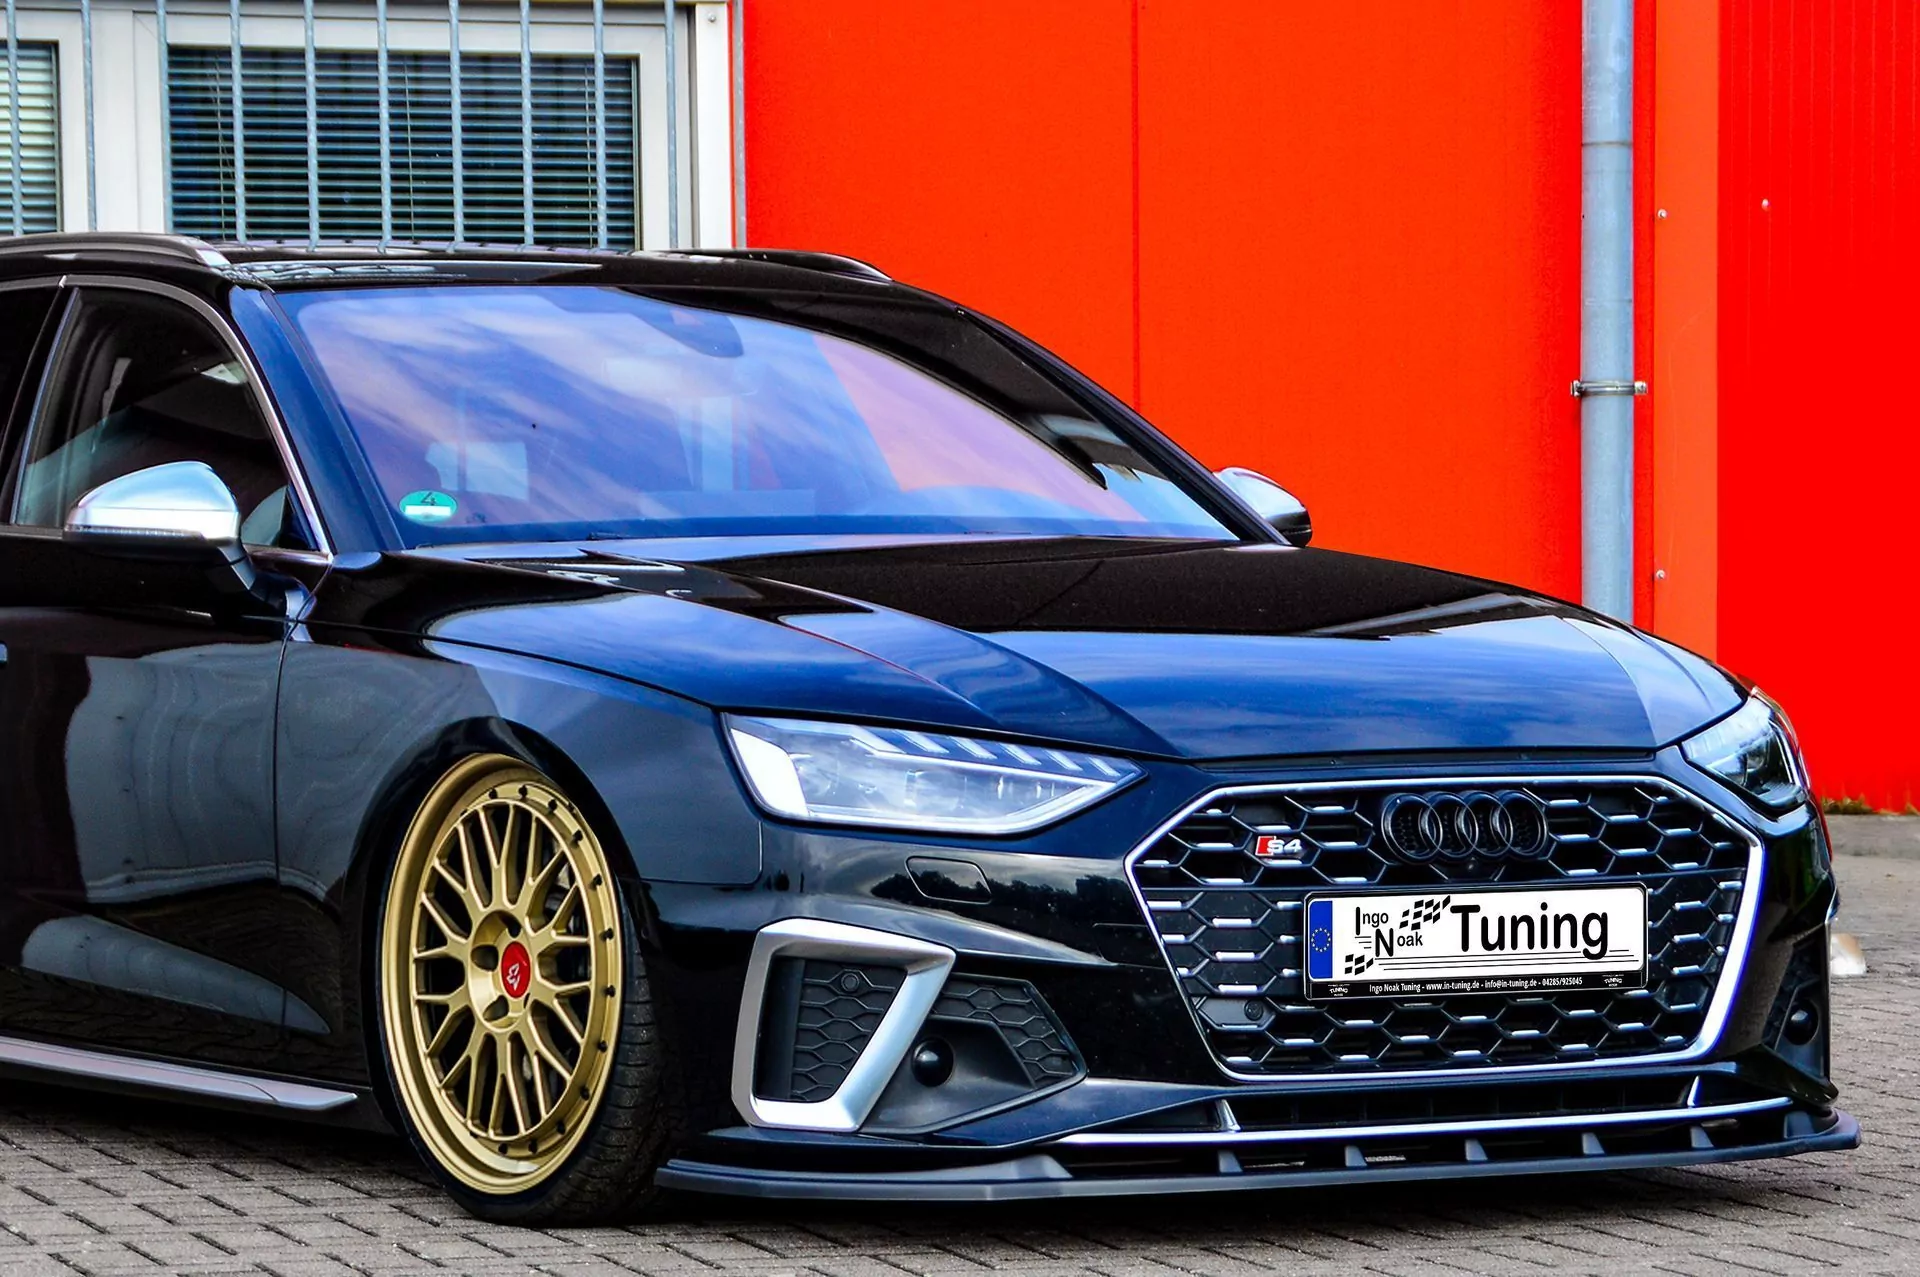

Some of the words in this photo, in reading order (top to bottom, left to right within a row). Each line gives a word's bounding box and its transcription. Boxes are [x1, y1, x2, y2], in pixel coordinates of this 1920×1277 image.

[421, 491, 436, 506] 4
[1267, 839, 1302, 854] S4
[1355, 906, 1389, 936] Ingo
[1450, 902, 1608, 960] Tuning
[1375, 928, 1423, 957] Noak
[1369, 984, 1382, 994] Ingo
[1383, 983, 1400, 992] Noak
[1401, 982, 1420, 993] Tuning
[1425, 980, 1480, 991] www.in-tuning.de
[1484, 978, 1537, 989] info@in-tuning.de
